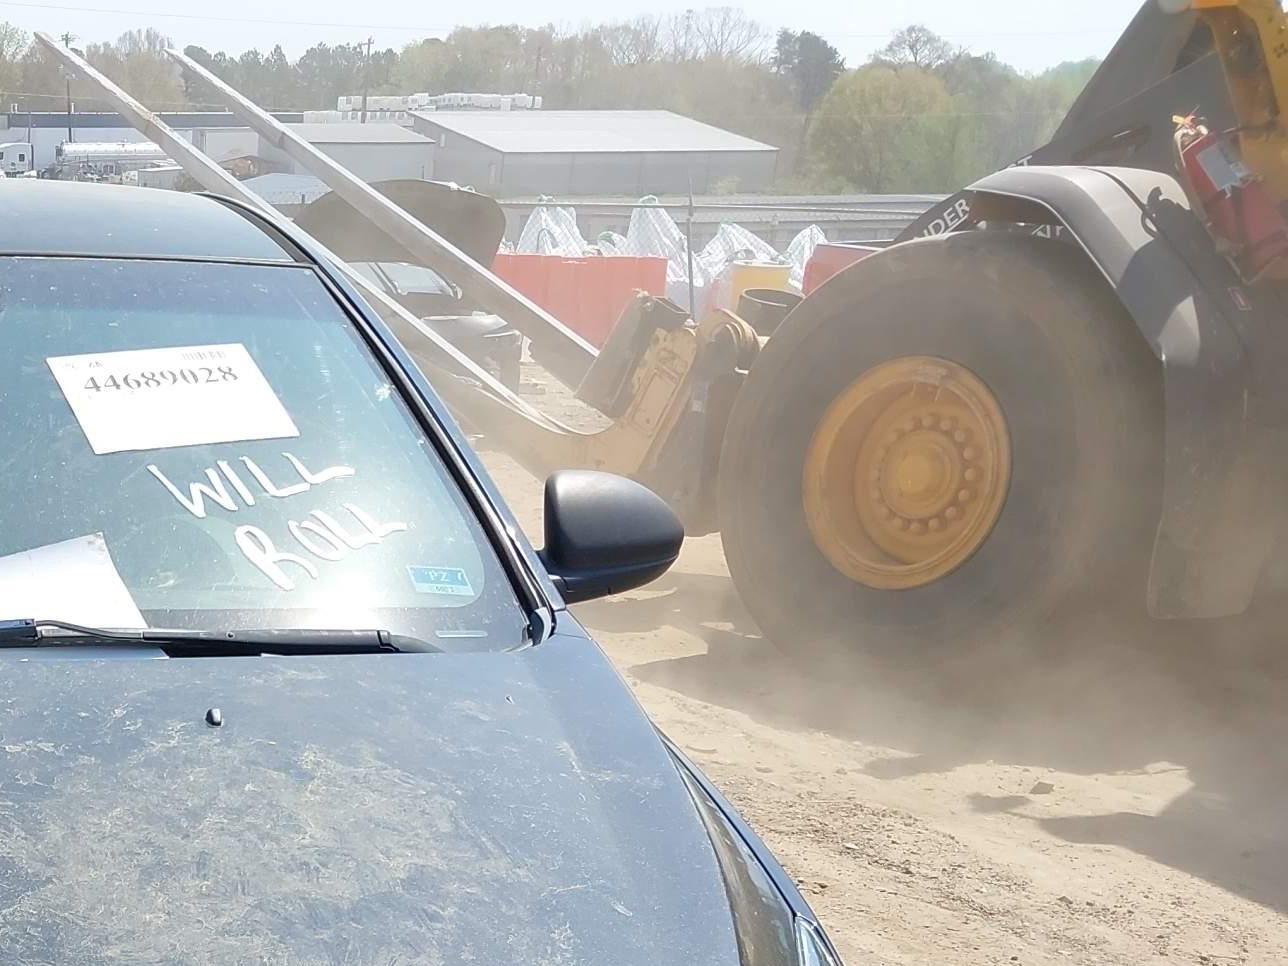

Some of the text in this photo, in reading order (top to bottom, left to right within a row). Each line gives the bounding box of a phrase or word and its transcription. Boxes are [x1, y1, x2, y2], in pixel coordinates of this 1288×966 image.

[83, 365, 240, 393] 44689028
[147, 452, 355, 518] WILL
[234, 502, 408, 591] ROLL
